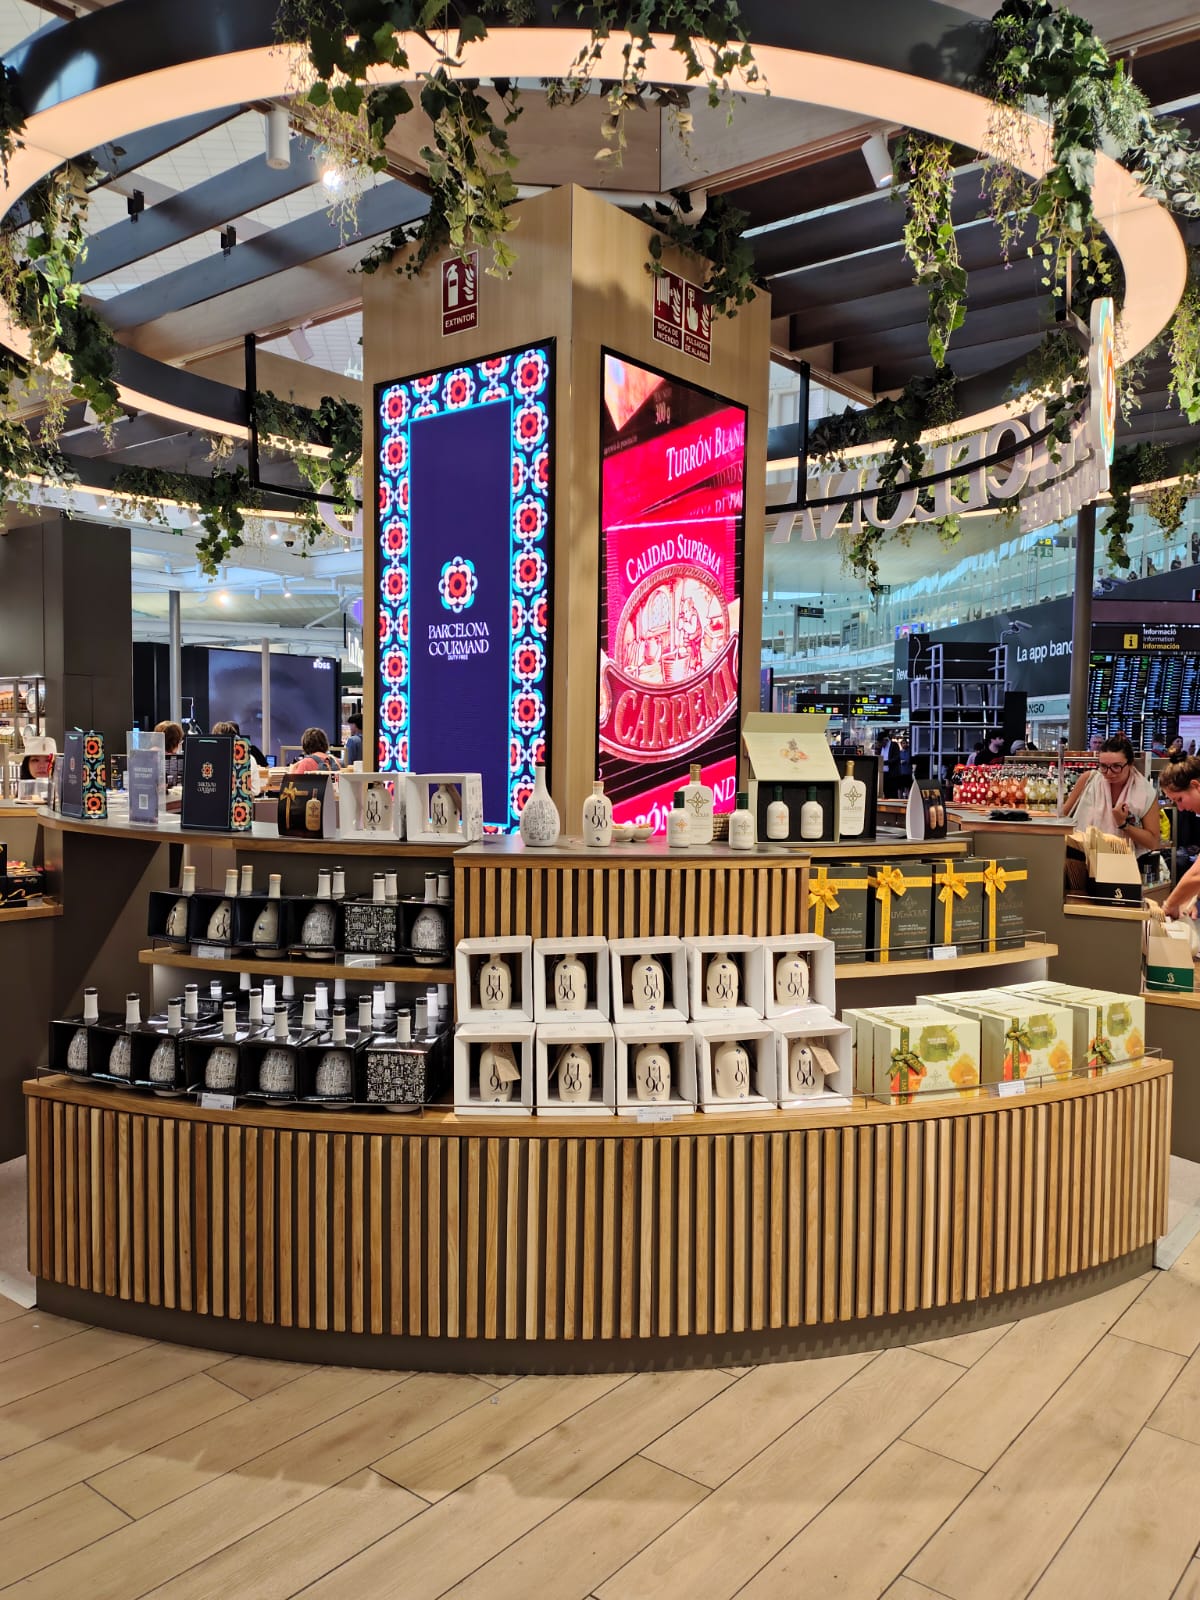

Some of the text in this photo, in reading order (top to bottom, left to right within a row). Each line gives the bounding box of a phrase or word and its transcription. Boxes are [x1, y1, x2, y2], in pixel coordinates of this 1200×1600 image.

[445, 312, 475, 328] EXTINTOR
[657, 321, 679, 338] BOCA DE
[657, 331, 680, 346] INCENDIO
[685, 335, 709, 352] PULSADOR
[665, 434, 713, 481] TURRÓN
[626, 533, 721, 584] CALIDAD SUPREMA
[428, 621, 490, 639] BARCELONA
[428, 639, 490, 656] GOURMAND
[1016, 646, 1027, 662] La
[1029, 648, 1047, 664] app
[614, 657, 737, 749] CARREMI
